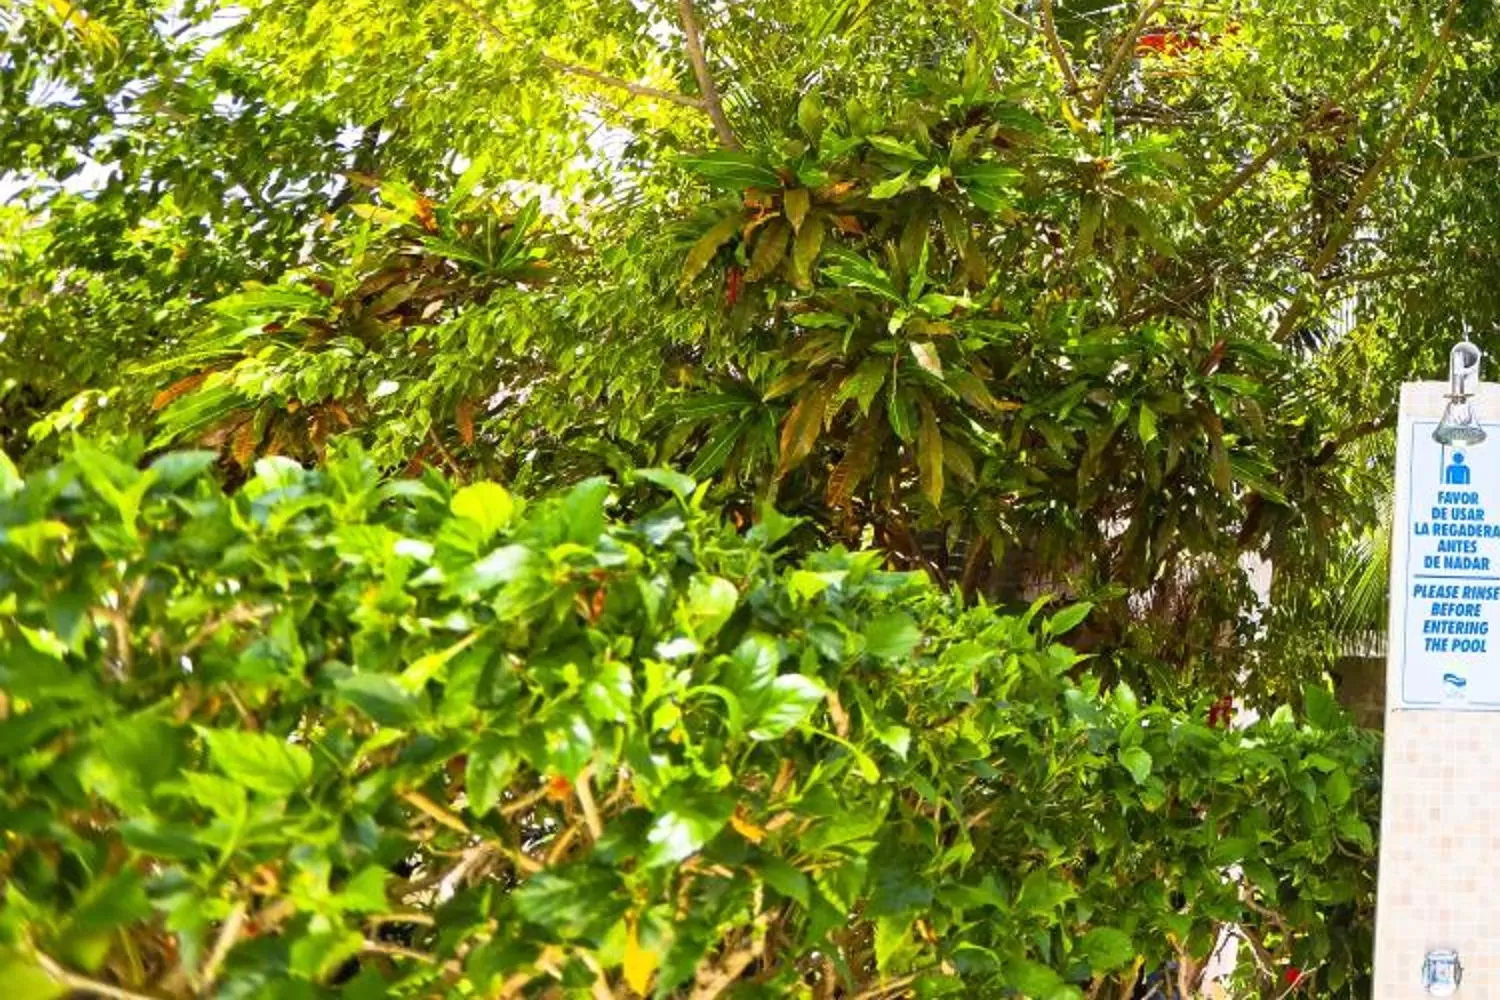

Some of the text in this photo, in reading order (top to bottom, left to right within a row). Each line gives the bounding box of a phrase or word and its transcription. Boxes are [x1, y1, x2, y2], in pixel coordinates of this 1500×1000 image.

[1438, 491, 1479, 505] FAVOR
[1432, 507, 1485, 521] DE USAR
[1415, 523, 1500, 538] LA REGADERA
[1437, 540, 1477, 553] ANTES
[1424, 556, 1489, 570] DE NADAR
[1414, 584, 1500, 600] PLEASE RINSE
[1431, 602, 1481, 617] BEFORE
[1423, 620, 1488, 635] ENTERING
[1425, 637, 1487, 653] THE POOL
